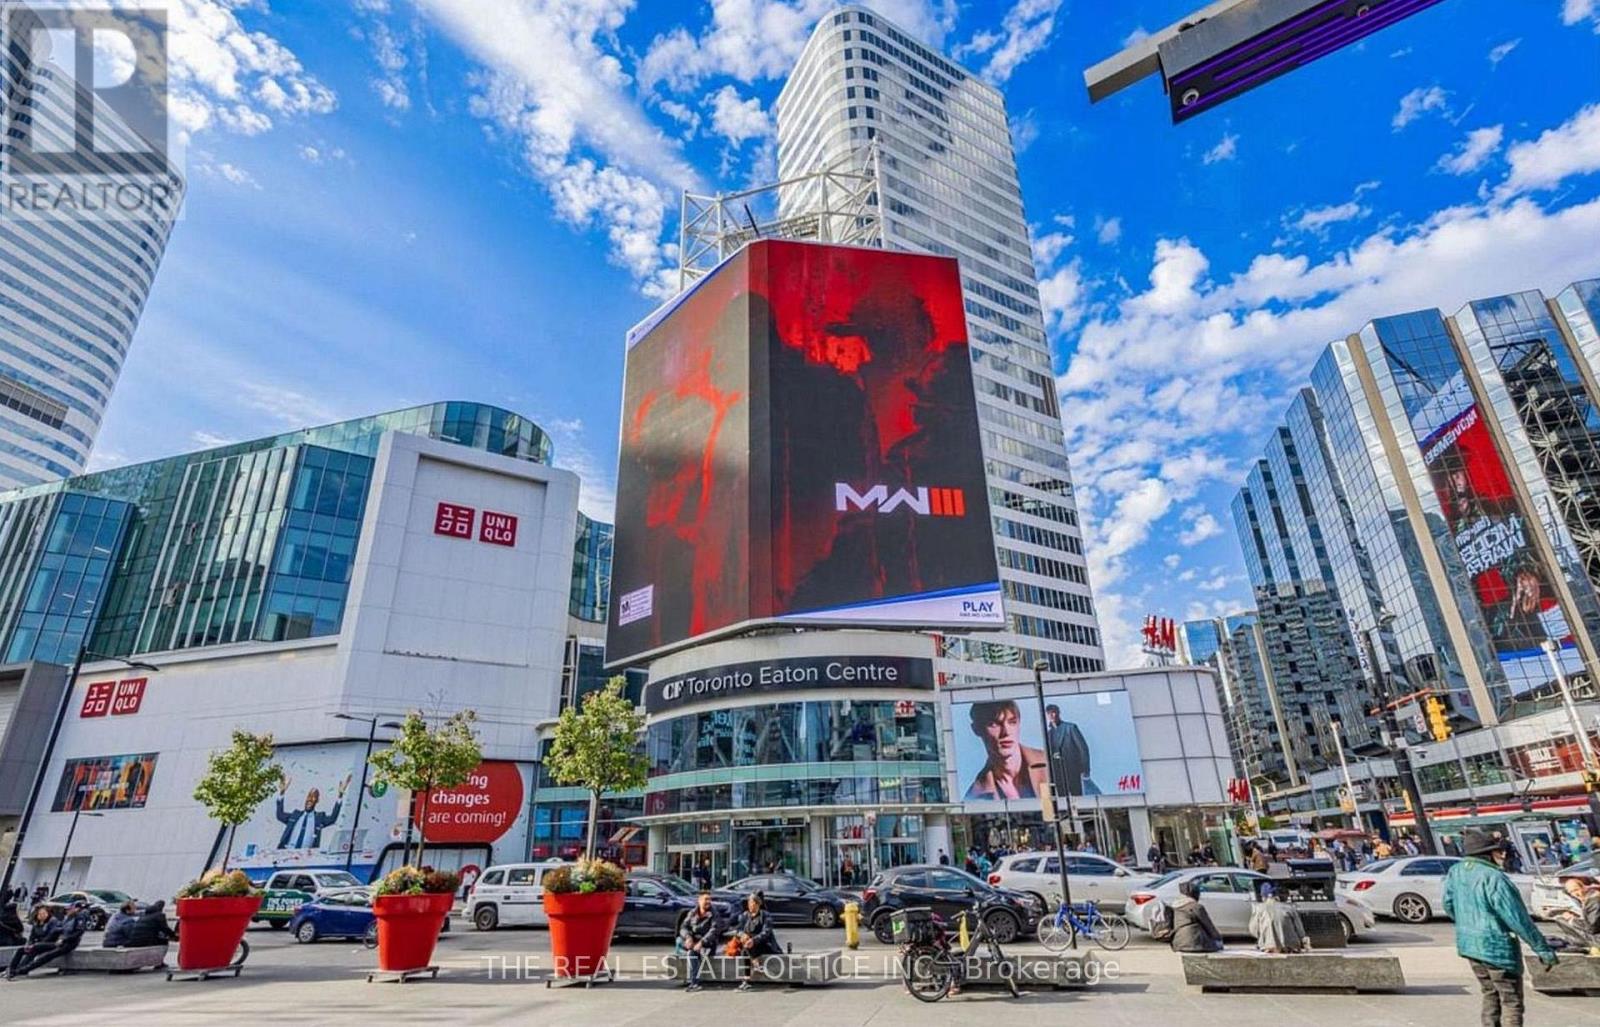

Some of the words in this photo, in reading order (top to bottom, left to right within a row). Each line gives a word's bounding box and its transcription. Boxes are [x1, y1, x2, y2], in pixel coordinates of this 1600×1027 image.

[486, 514, 511, 530] UNI
[484, 527, 512, 542] QLO
[963, 601, 994, 612] PLAY
[686, 671, 753, 695] Toronto
[760, 666, 818, 685] Eaton
[826, 662, 898, 681] Centre
[119, 682, 141, 696] UNI
[114, 696, 138, 712] QLO
[466, 772, 489, 789] ing
[431, 790, 491, 808] changes
[428, 812, 451, 824] are
[454, 810, 507, 827] coming!
